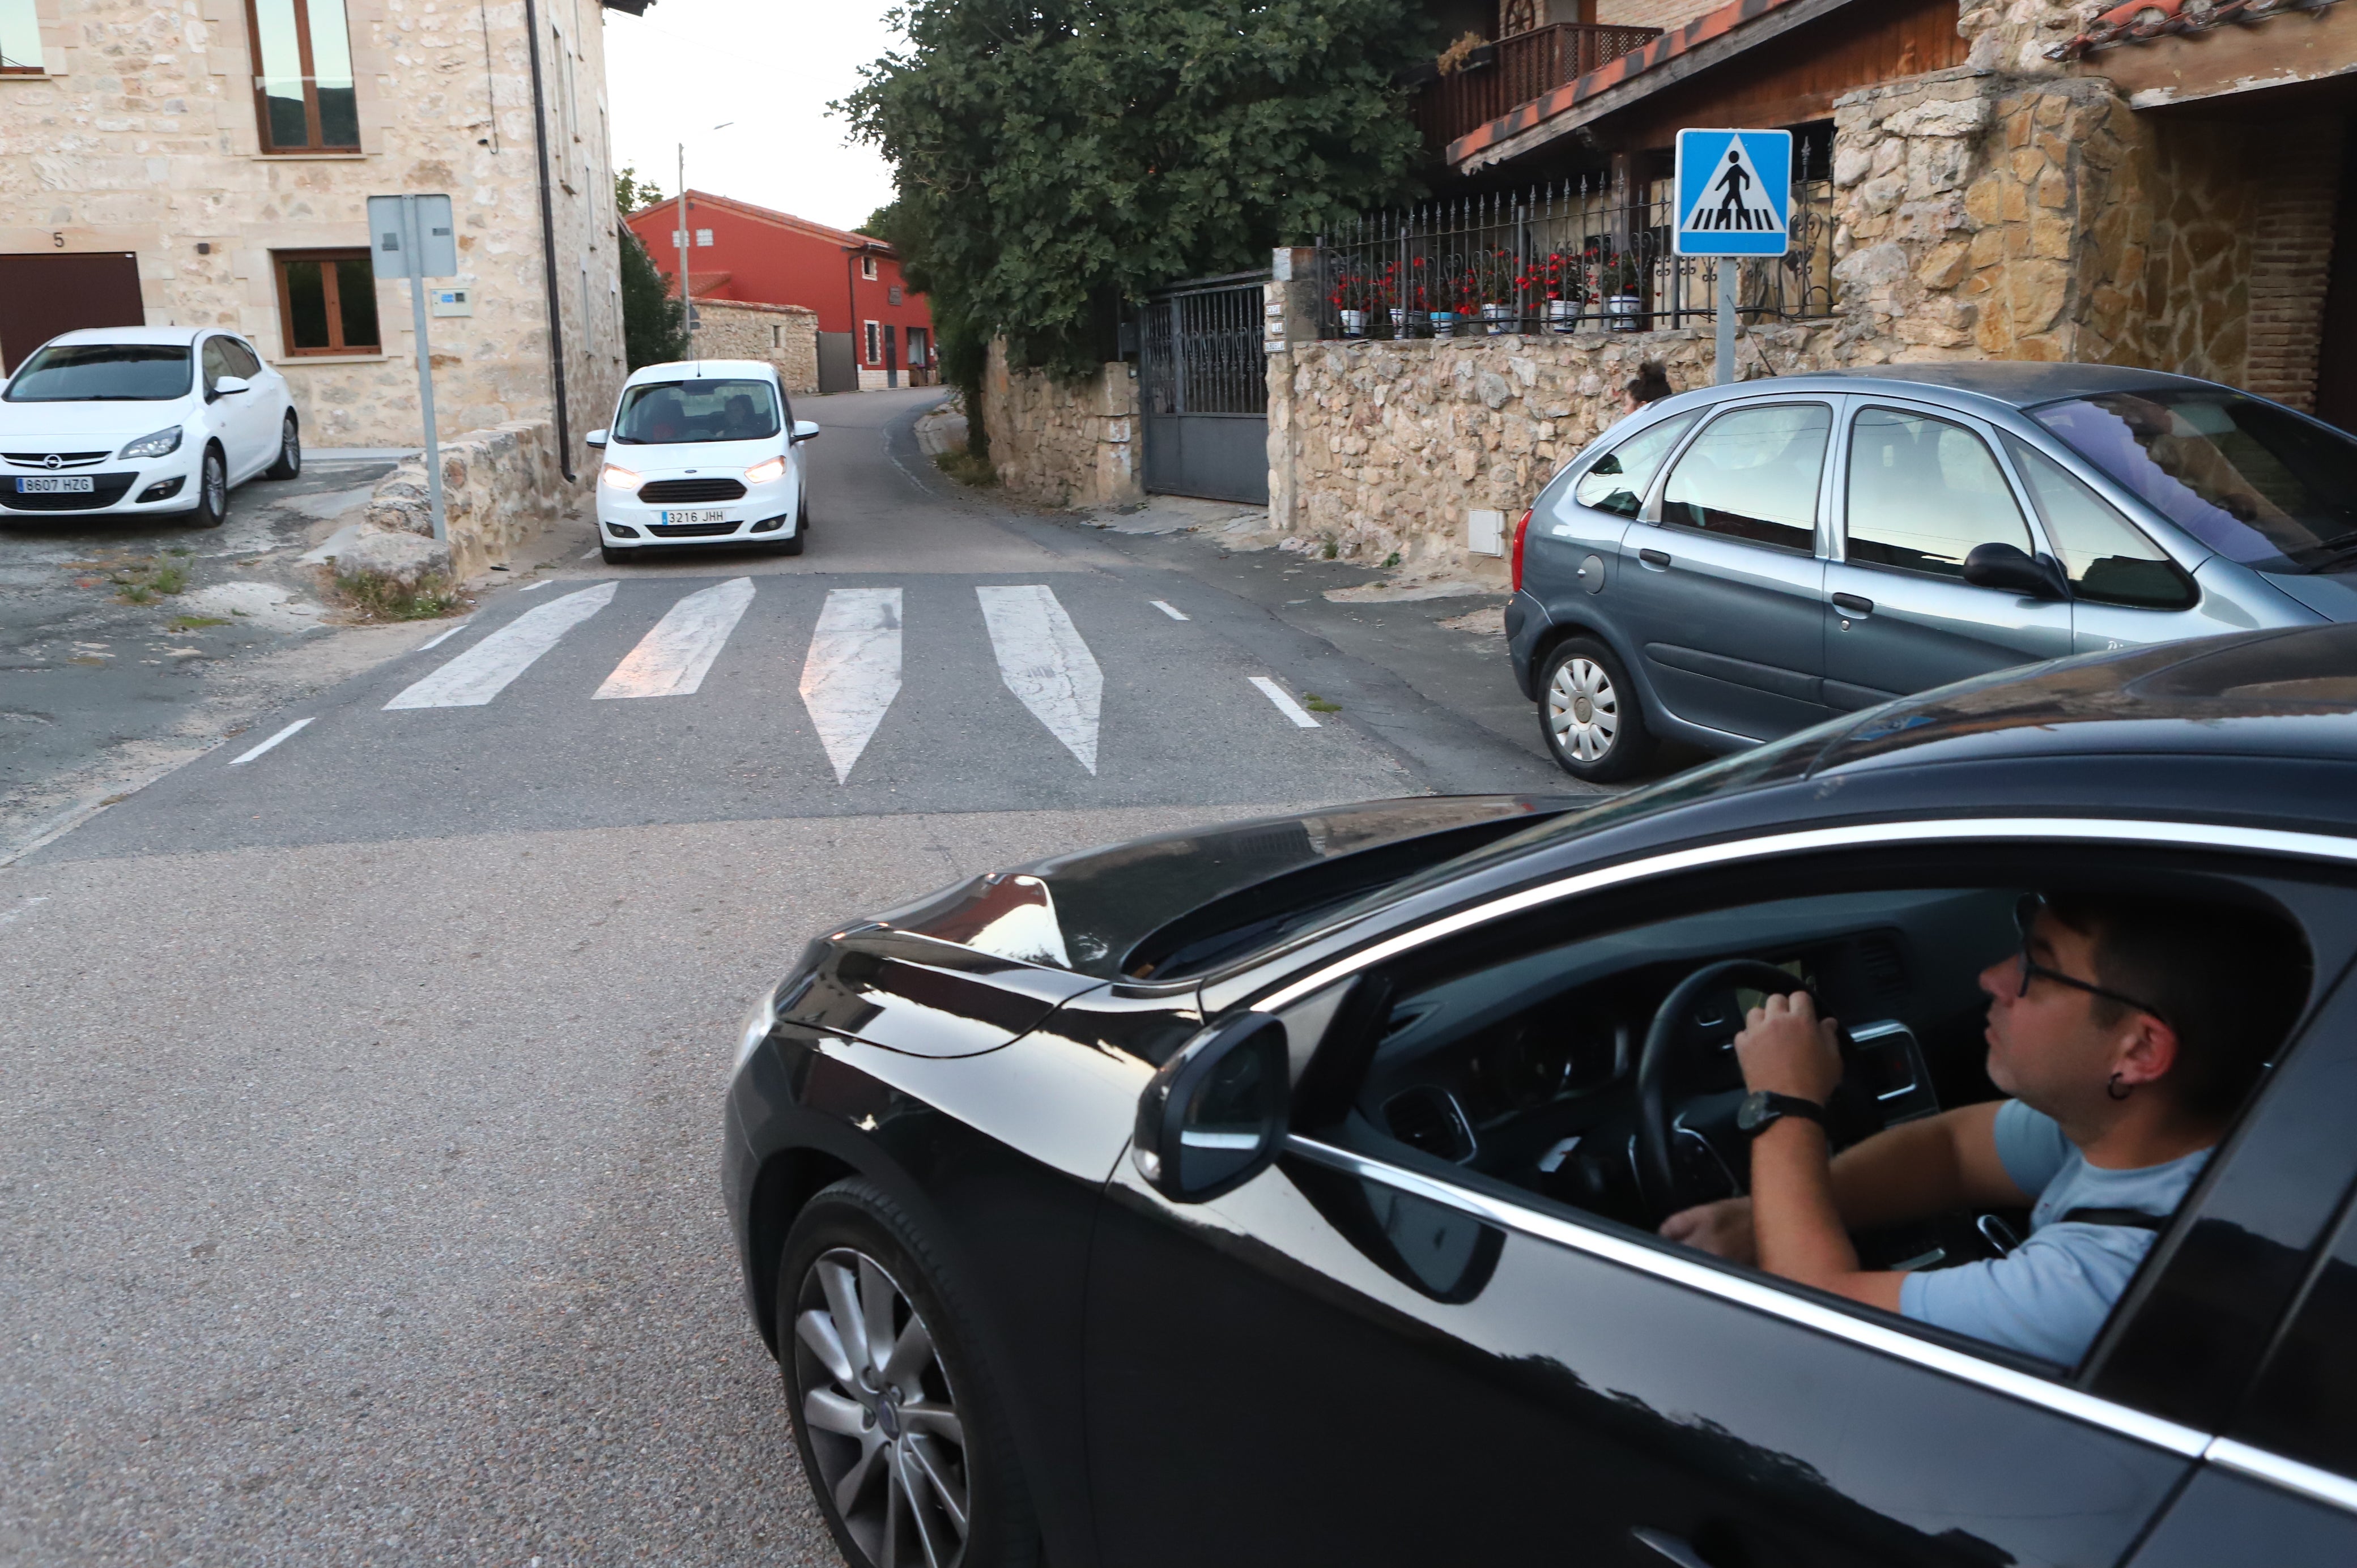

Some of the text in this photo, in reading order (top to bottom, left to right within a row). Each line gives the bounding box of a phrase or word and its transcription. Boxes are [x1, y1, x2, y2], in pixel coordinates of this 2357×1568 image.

[53, 232, 65, 248] 5
[26, 479, 89, 491] 8607 HZG
[669, 511, 724, 523] 3216 JHH
